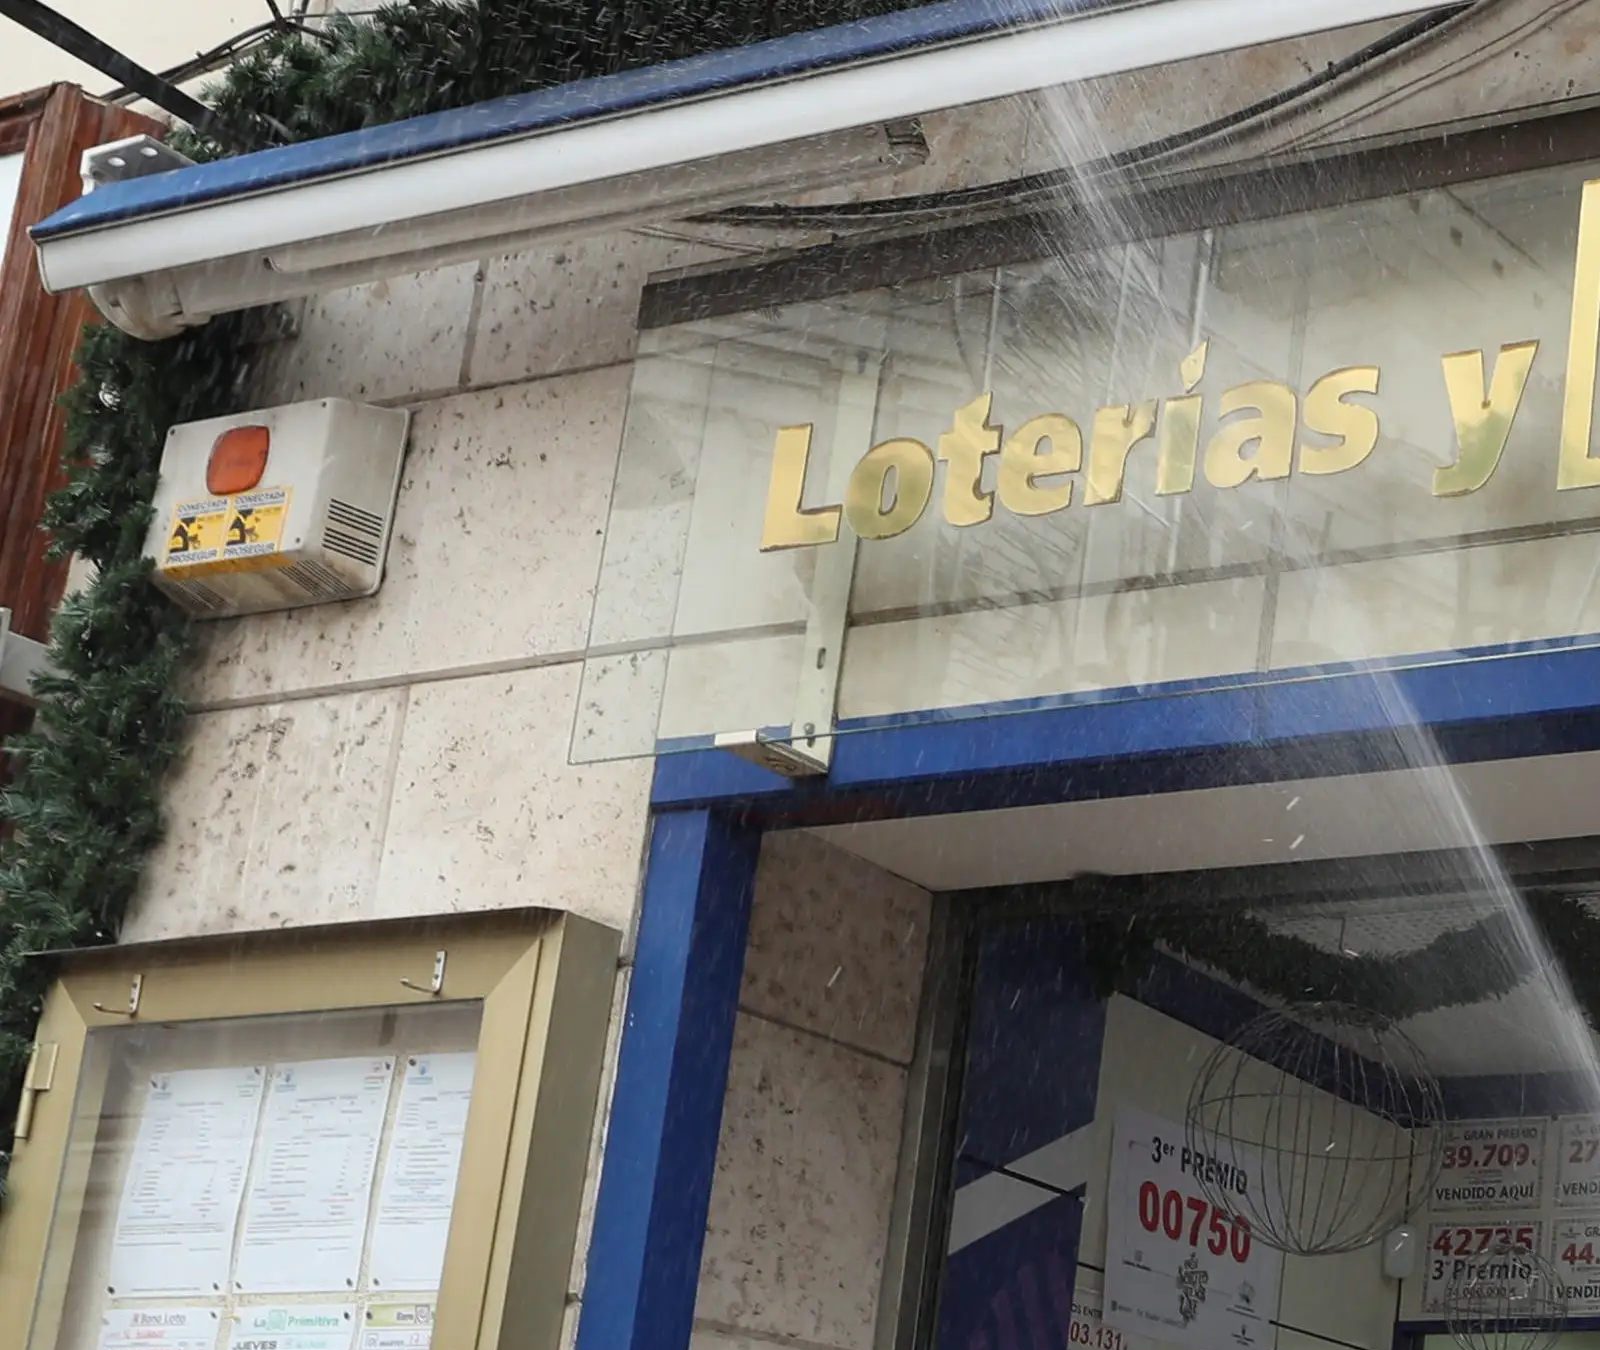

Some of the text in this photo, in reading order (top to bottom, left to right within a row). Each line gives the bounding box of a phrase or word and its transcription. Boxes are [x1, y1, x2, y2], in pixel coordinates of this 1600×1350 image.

[760, 339, 1381, 552] Loterías
[1434, 339, 1541, 496] y
[1151, 1136, 1249, 1195] 3er PREMIO
[1435, 1183, 1534, 1201] VENDIDO AQUÍ
[1138, 1180, 1251, 1264] 00750
